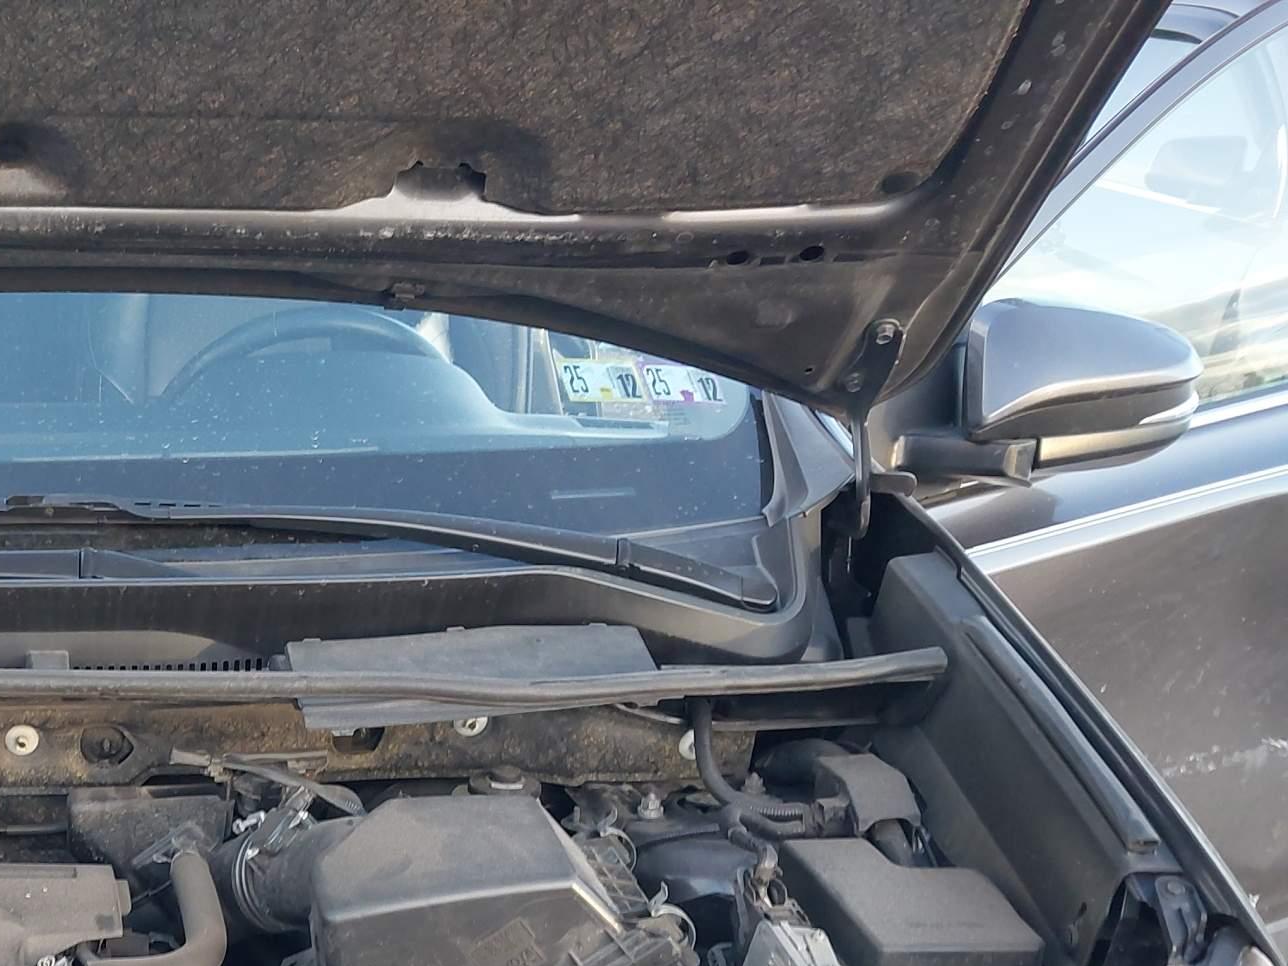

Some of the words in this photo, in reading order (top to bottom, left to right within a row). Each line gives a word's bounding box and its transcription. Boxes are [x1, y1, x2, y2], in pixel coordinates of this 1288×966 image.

[563, 365, 589, 393] 25
[616, 373, 642, 398] 12
[646, 368, 671, 395] 25
[697, 377, 724, 402] 12
